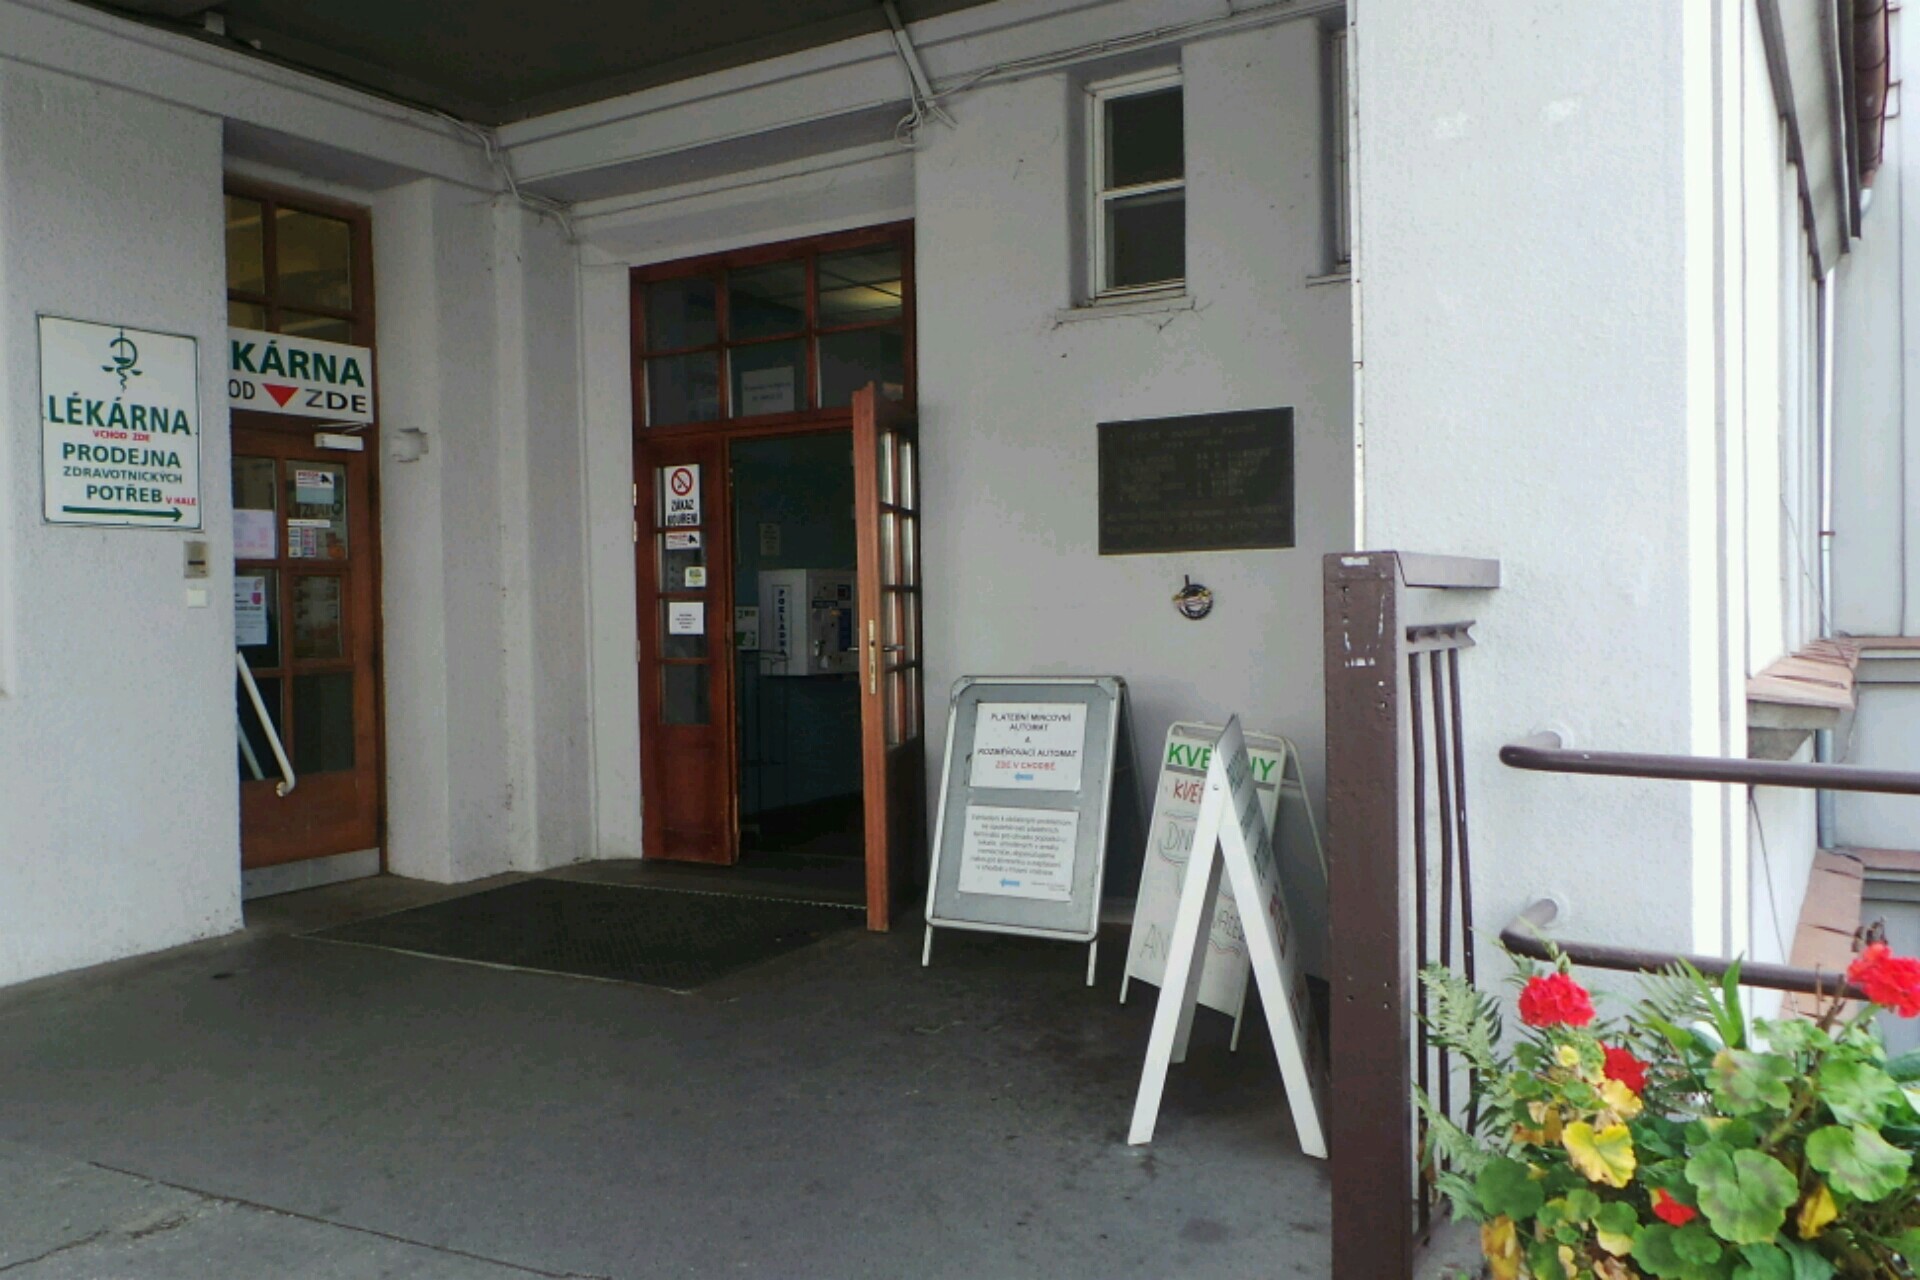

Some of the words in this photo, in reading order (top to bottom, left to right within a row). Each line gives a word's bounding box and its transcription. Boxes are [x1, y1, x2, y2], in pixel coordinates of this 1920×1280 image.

[232, 340, 364, 388] KÁRNA
[229, 379, 255, 400] OD
[305, 388, 367, 414] ZDE
[48, 392, 191, 436] LÉKÁRNA
[92, 429, 128, 441] VCHOD
[62, 442, 182, 469] PRODEJNA
[63, 465, 182, 484] ZDRAVOTNICKÝCH
[86, 483, 163, 504] POTŘEB
[1009, 723, 1048, 731] AUTOMAT
